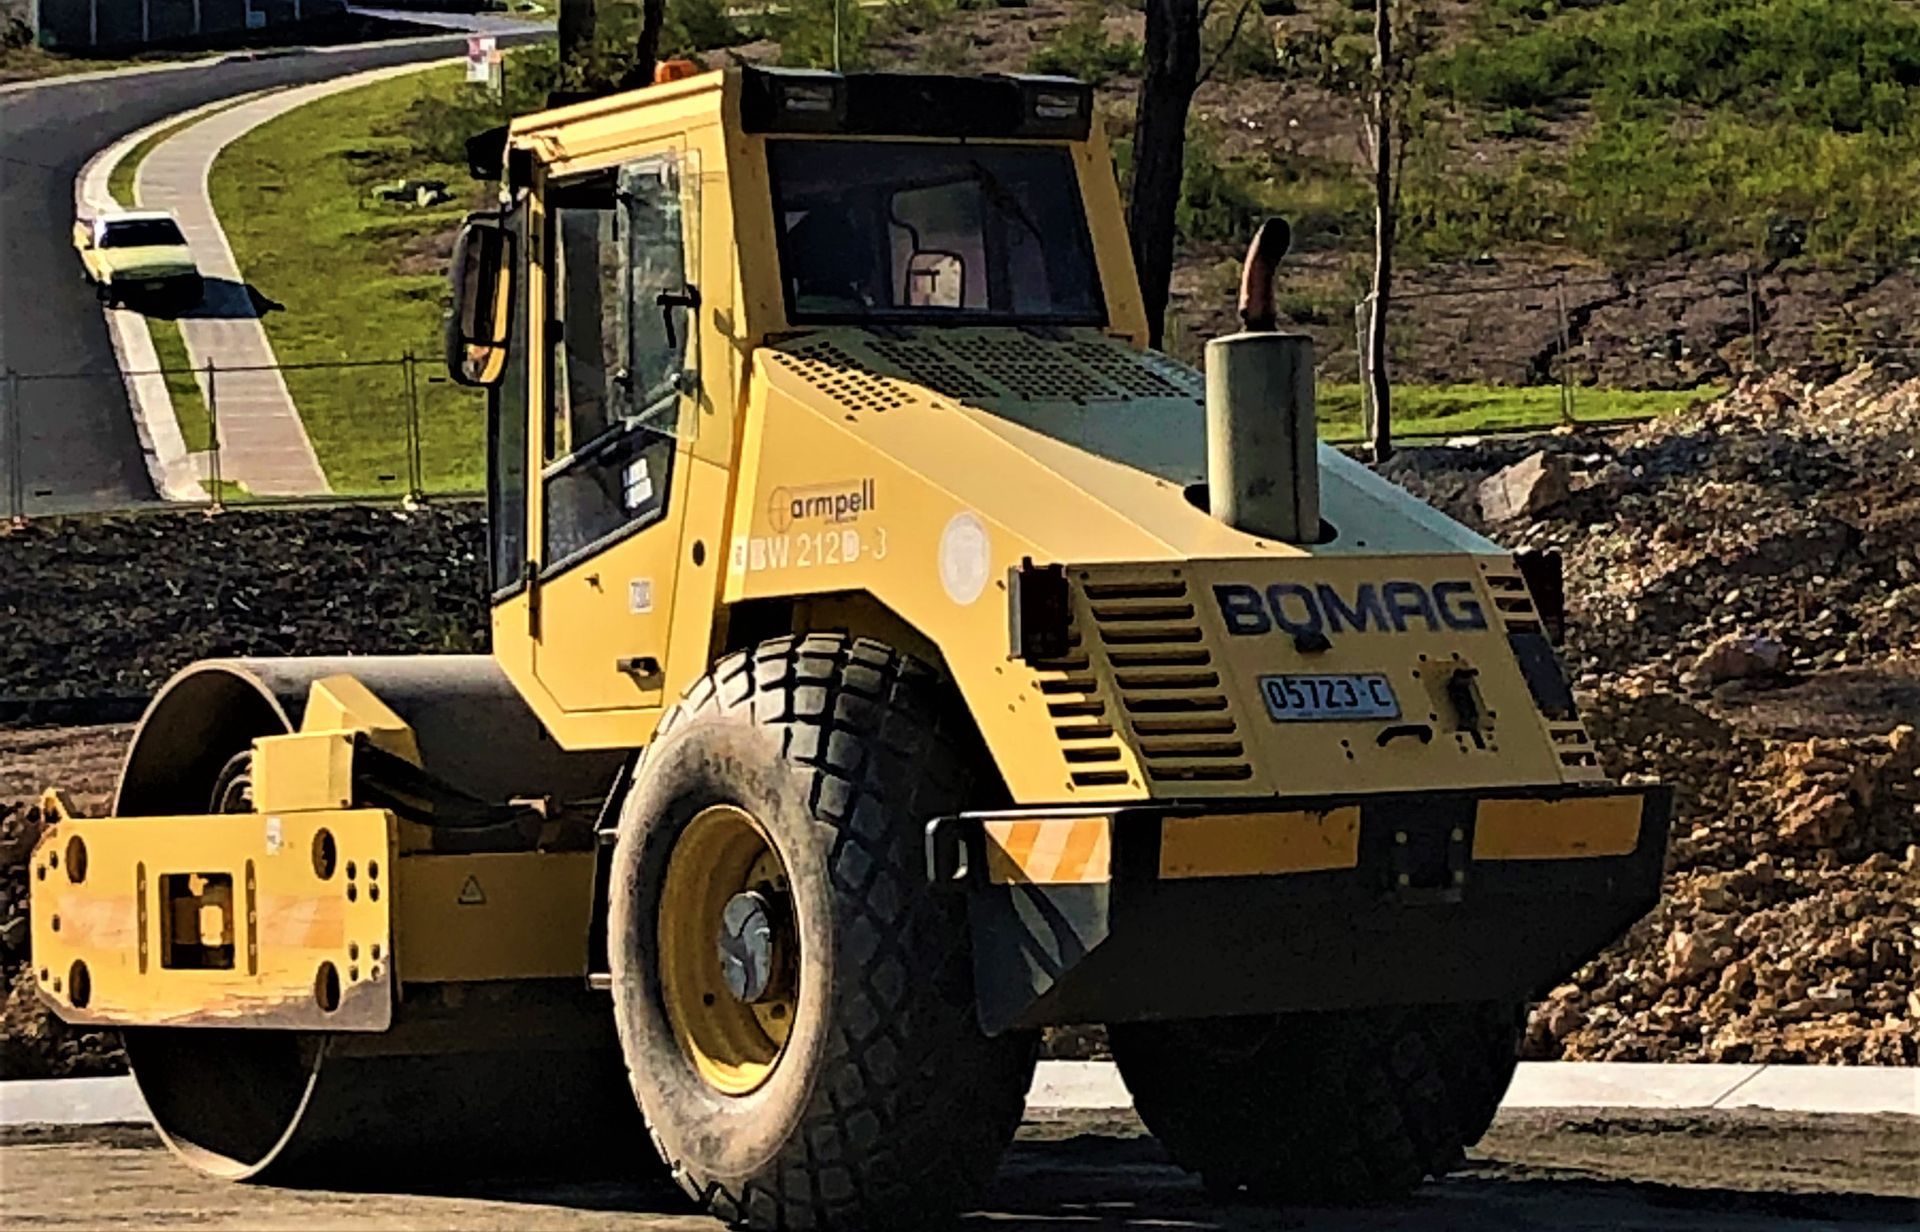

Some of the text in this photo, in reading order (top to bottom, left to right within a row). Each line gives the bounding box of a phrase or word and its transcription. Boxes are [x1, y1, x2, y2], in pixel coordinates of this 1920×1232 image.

[750, 534, 789, 570] BW
[796, 526, 887, 567] 212D-3
[1212, 581, 1489, 636] BOMAG
